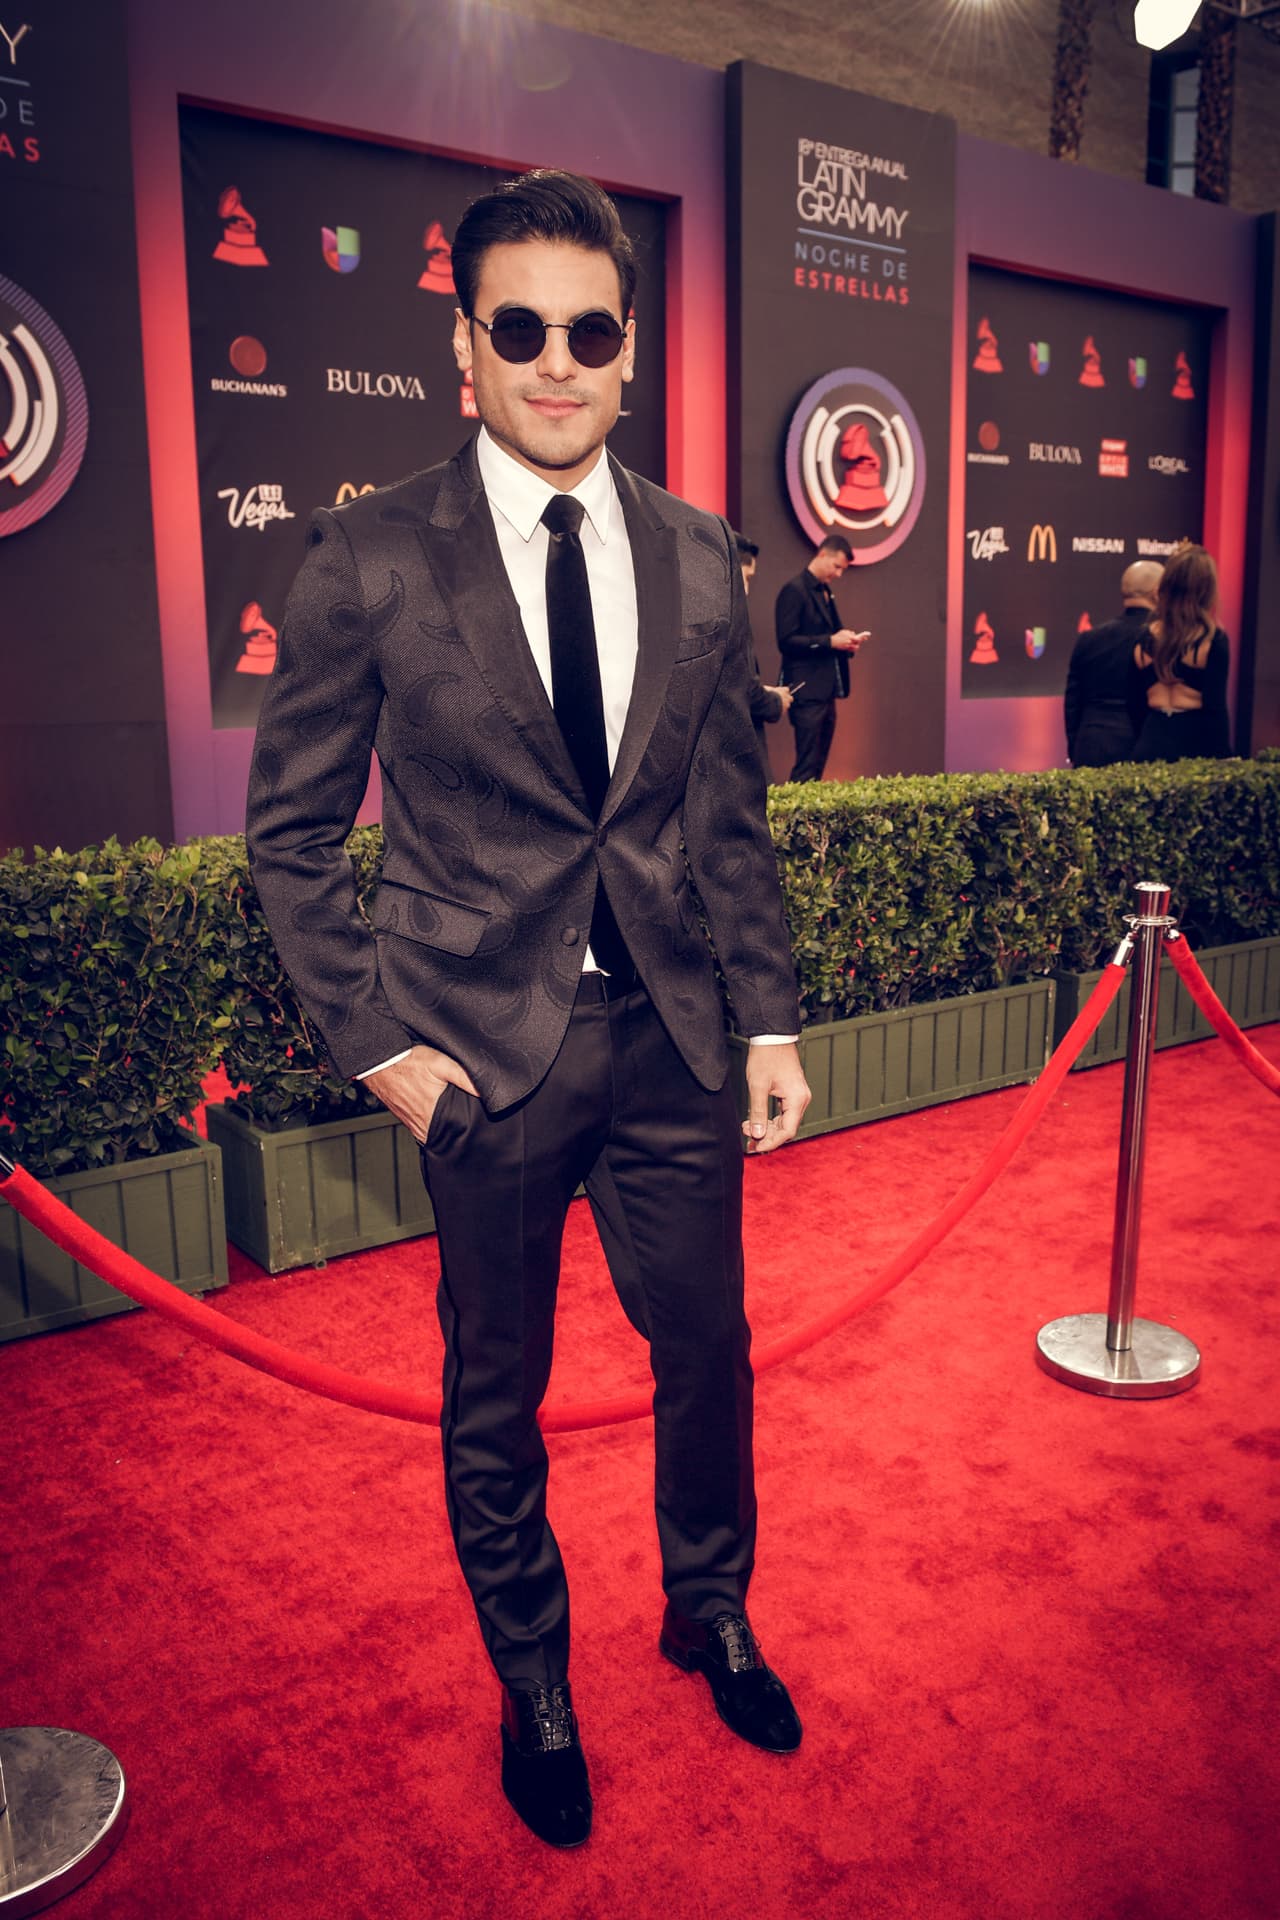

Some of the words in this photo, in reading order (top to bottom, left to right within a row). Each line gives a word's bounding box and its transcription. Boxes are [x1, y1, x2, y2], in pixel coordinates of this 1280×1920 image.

[798, 153, 866, 200] LATIN
[796, 186, 909, 239] GRAMMY
[795, 241, 870, 273] NOCHE
[882, 258, 908, 280] DE
[794, 266, 910, 305] ESTRELLAS
[326, 367, 426, 400] BULOVA
[1028, 442, 1082, 465] BULOVA
[217, 486, 296, 532] Vegas
[1072, 536, 1125, 554] NISSAN
